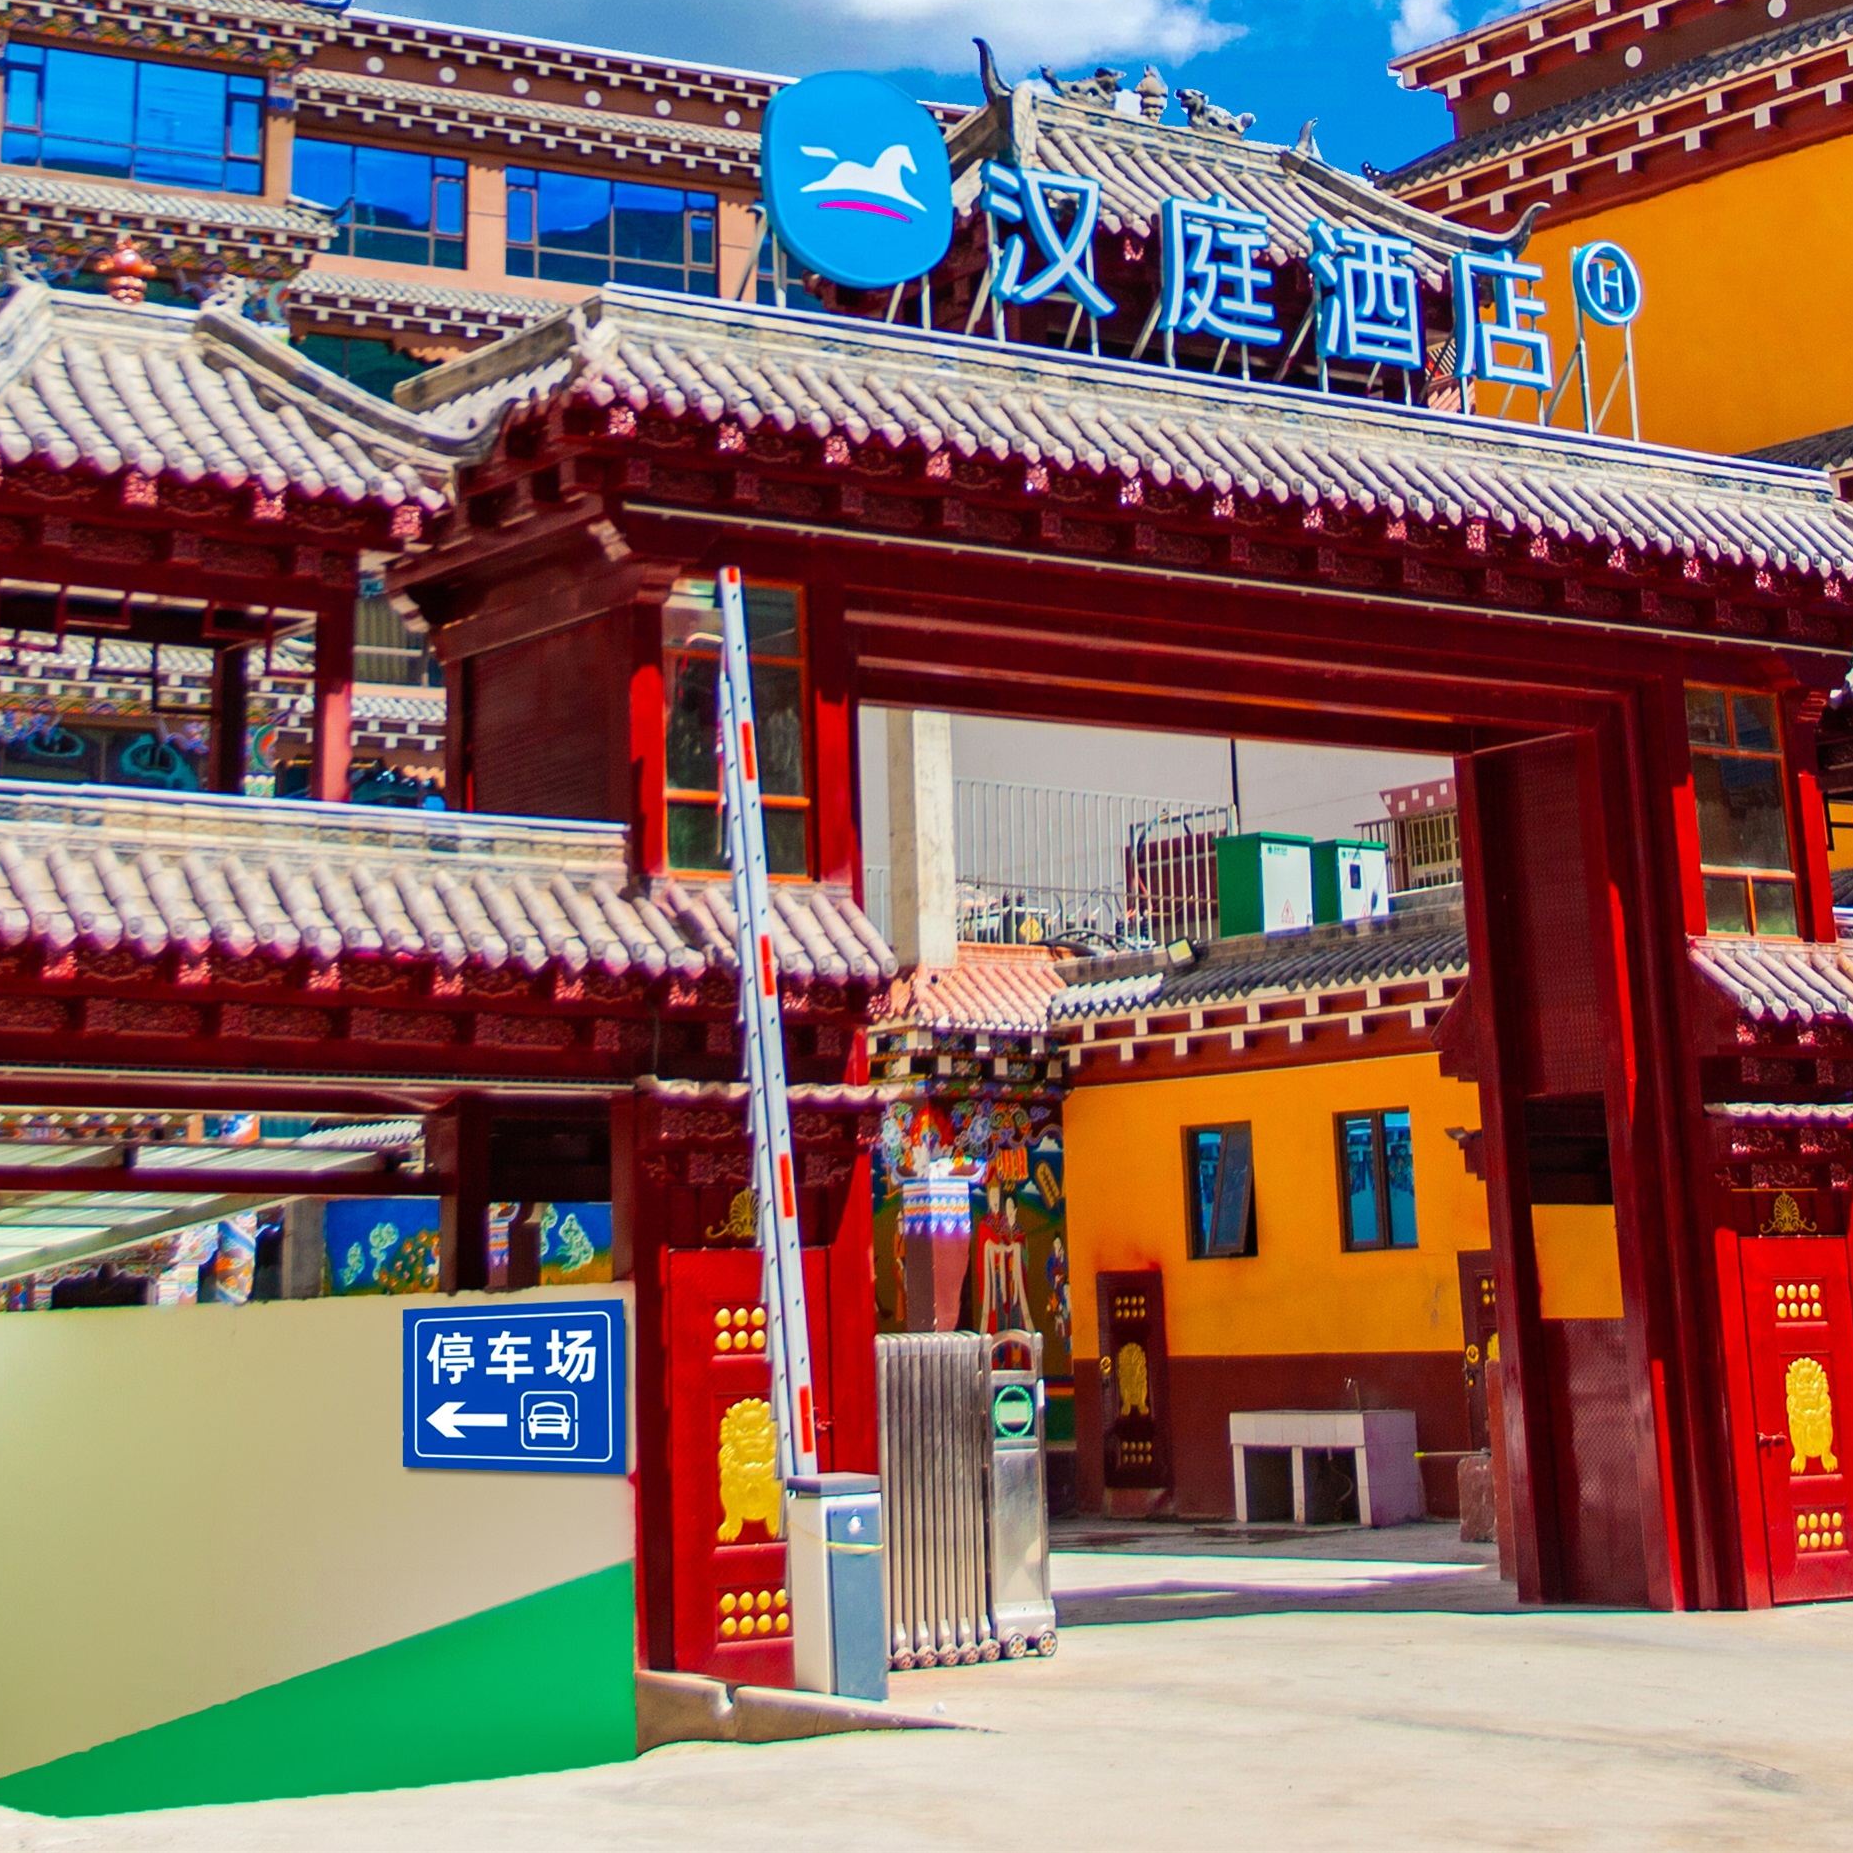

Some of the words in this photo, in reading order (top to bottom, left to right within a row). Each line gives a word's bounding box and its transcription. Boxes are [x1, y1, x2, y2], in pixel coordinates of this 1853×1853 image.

[979, 158, 1553, 391] 汉庭酒店
[426, 1328, 597, 1385] 停车场
